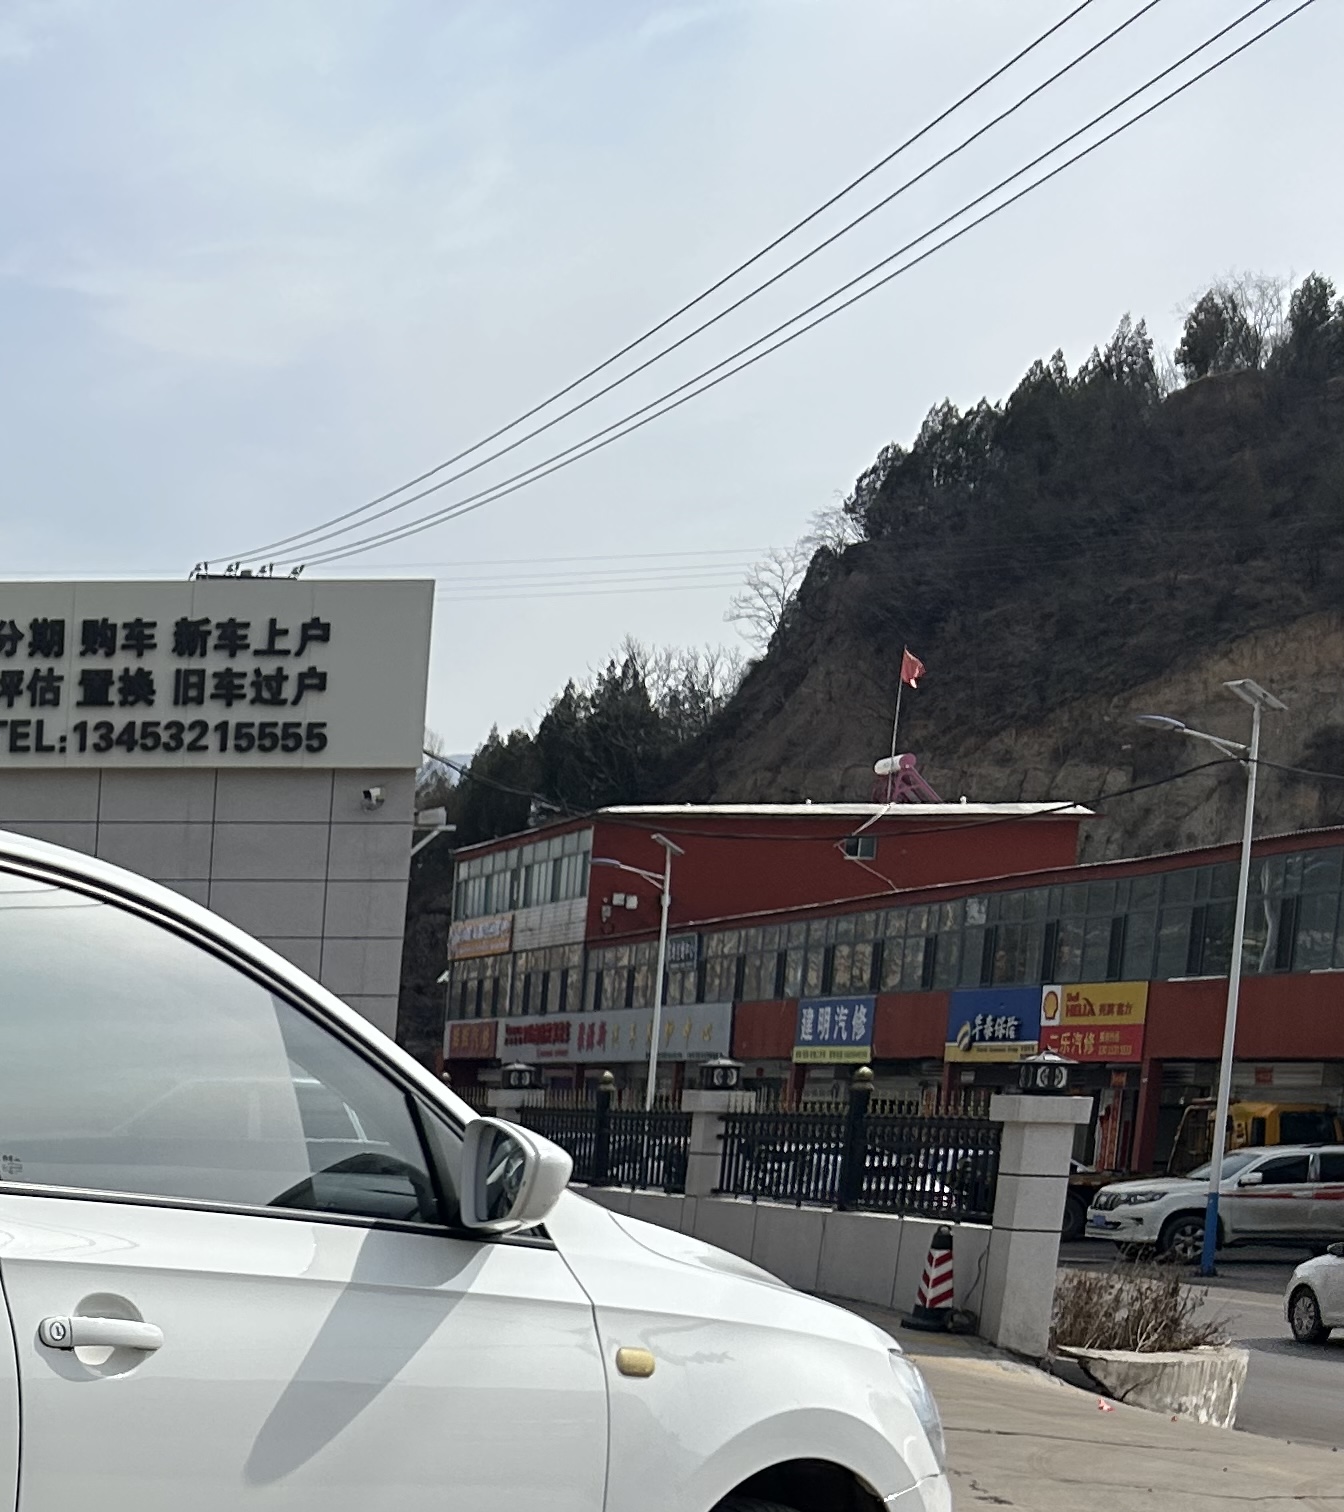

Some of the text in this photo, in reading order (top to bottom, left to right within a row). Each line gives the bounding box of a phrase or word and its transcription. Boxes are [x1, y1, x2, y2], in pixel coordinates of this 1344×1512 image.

[79, 617, 158, 658] 购车
[171, 616, 332, 658] 新车上户
[75, 667, 157, 708] 置换
[172, 666, 329, 707] 旧车过户
[800, 1004, 867, 1041] 建明汽修
